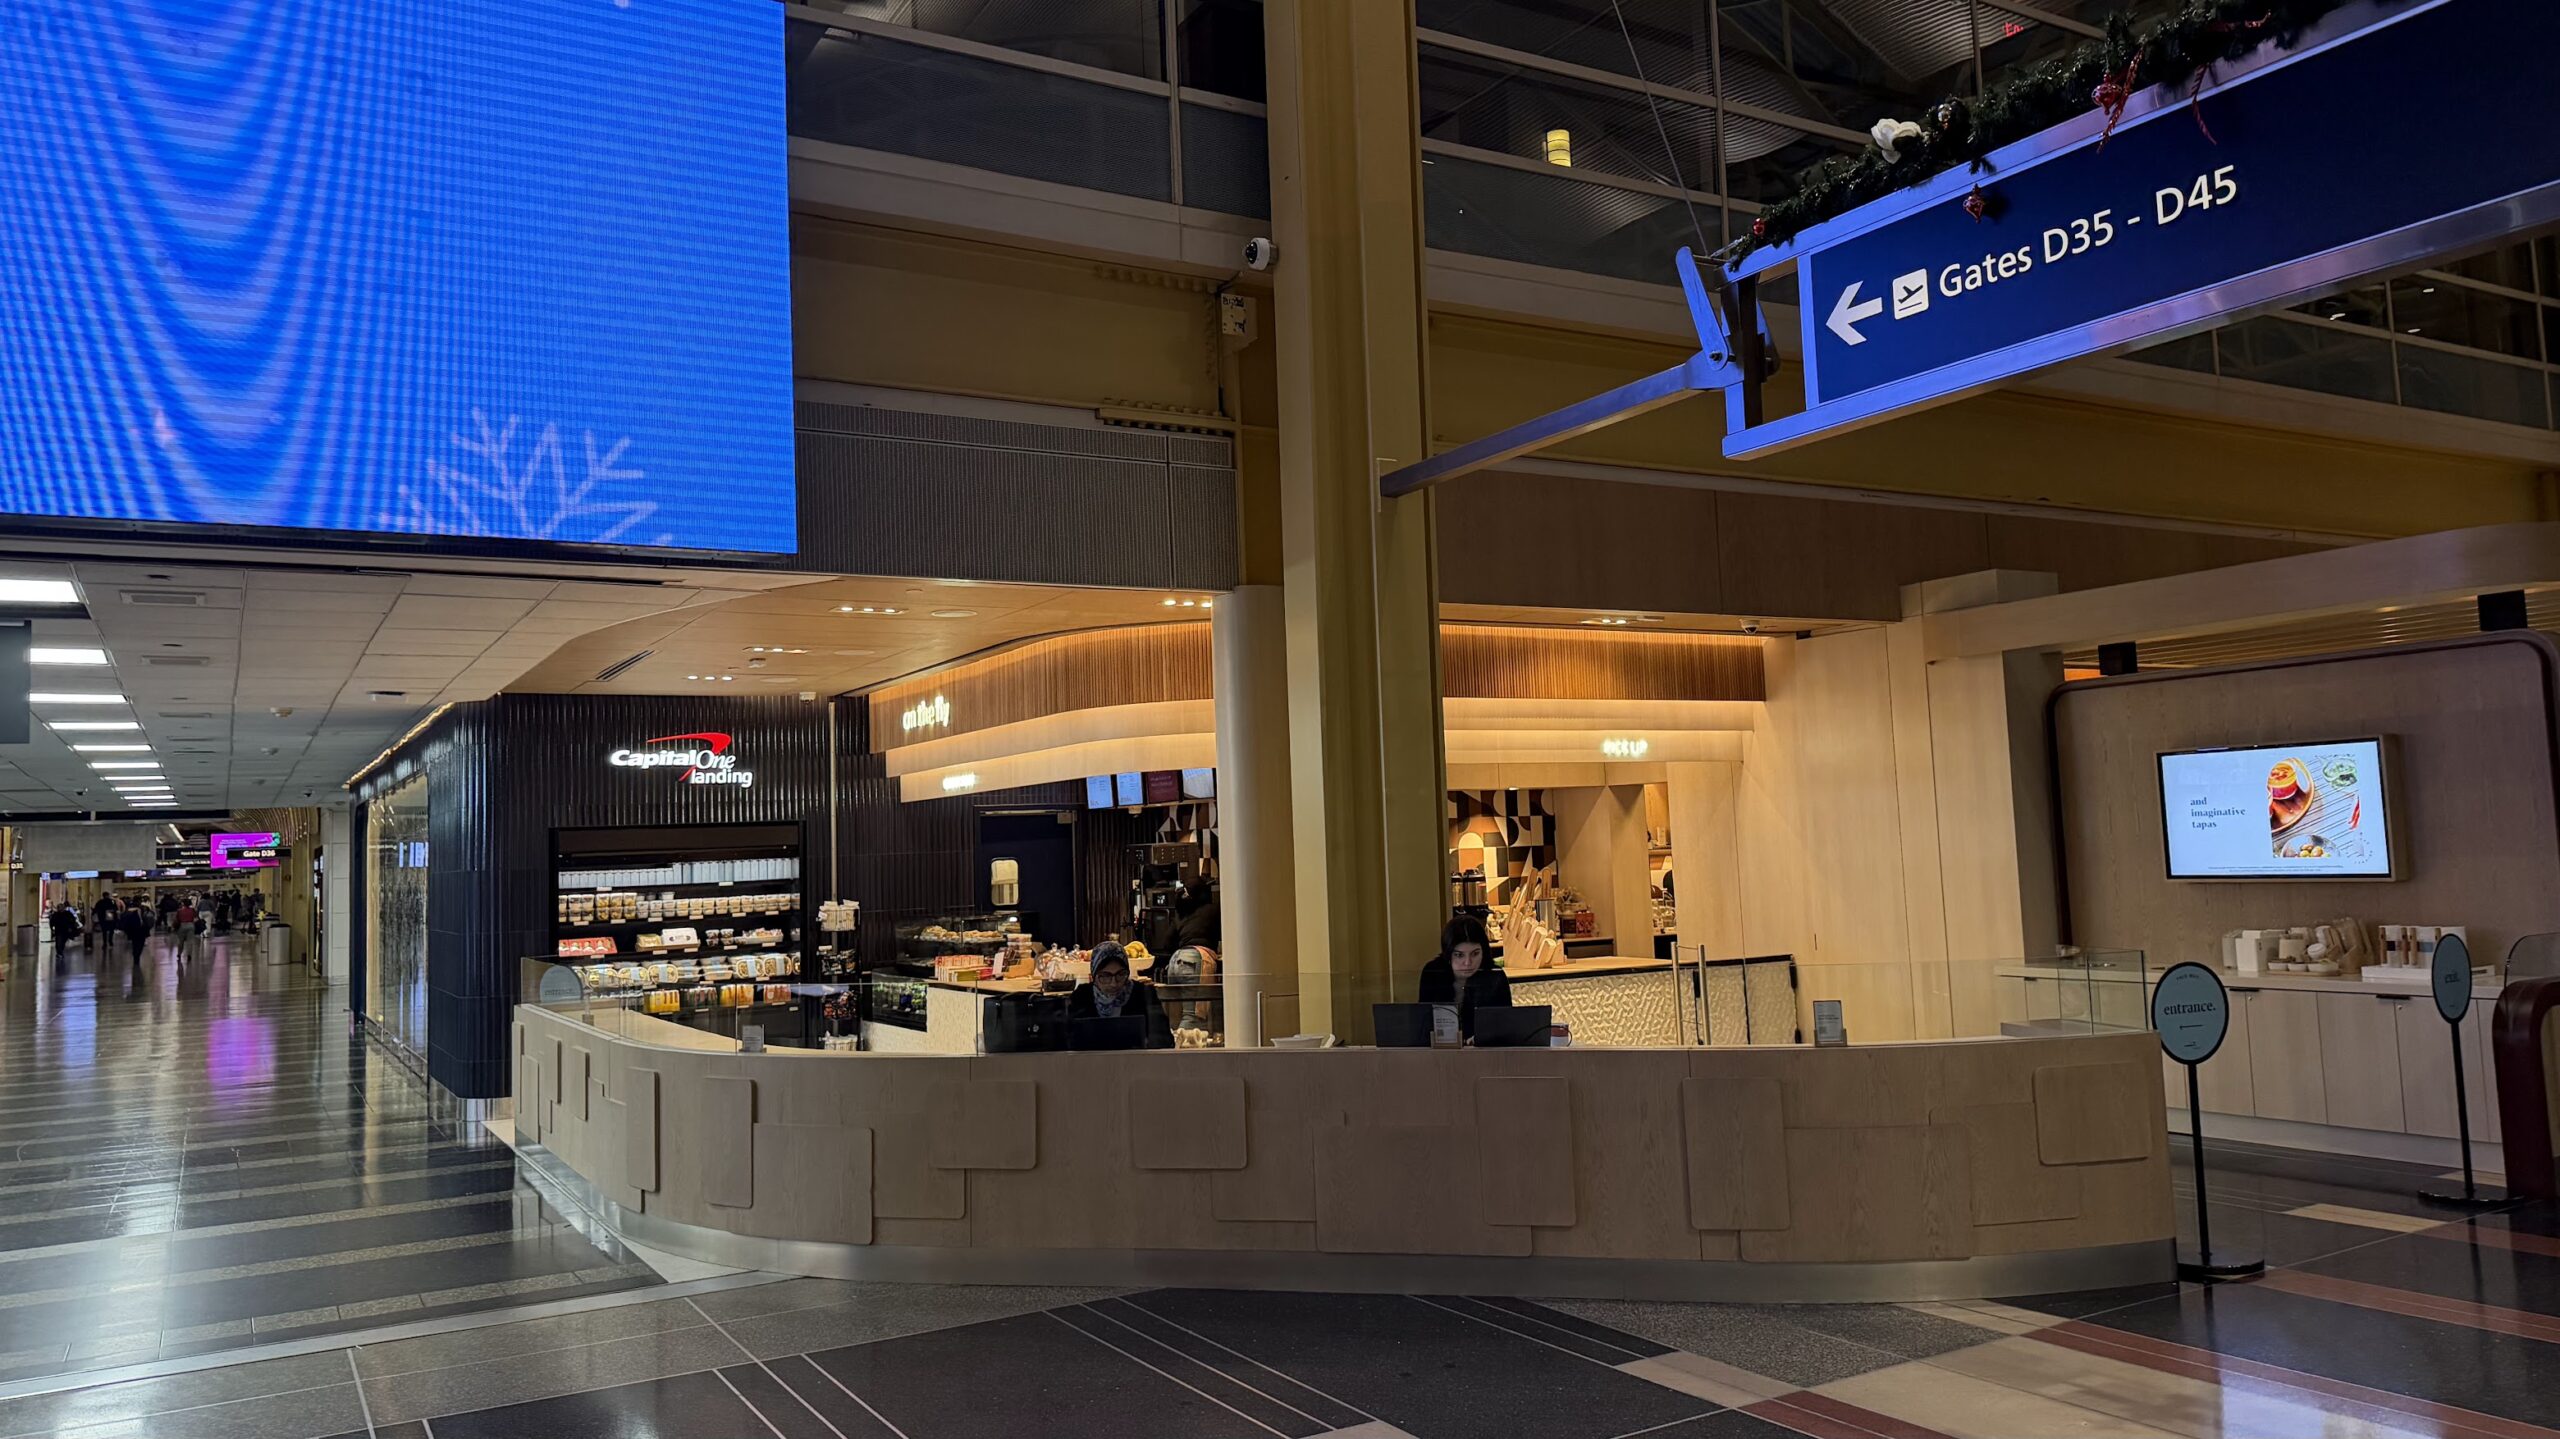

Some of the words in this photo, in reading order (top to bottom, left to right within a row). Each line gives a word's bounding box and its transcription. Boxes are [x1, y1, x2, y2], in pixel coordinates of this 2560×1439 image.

[1939, 245, 2033, 298] Gates
[2042, 208, 2114, 264] D35
[2127, 216, 2141, 225] -
[2155, 164, 2238, 226] D45
[917, 699, 935, 728] the
[934, 694, 950, 728] fly
[690, 768, 754, 789] landing
[2190, 796, 2208, 806] and
[2191, 807, 2246, 818] imaginative
[2192, 821, 2217, 830] tapas
[242, 850, 261, 858] Gate
[2163, 1001, 2217, 1016] entrance.
